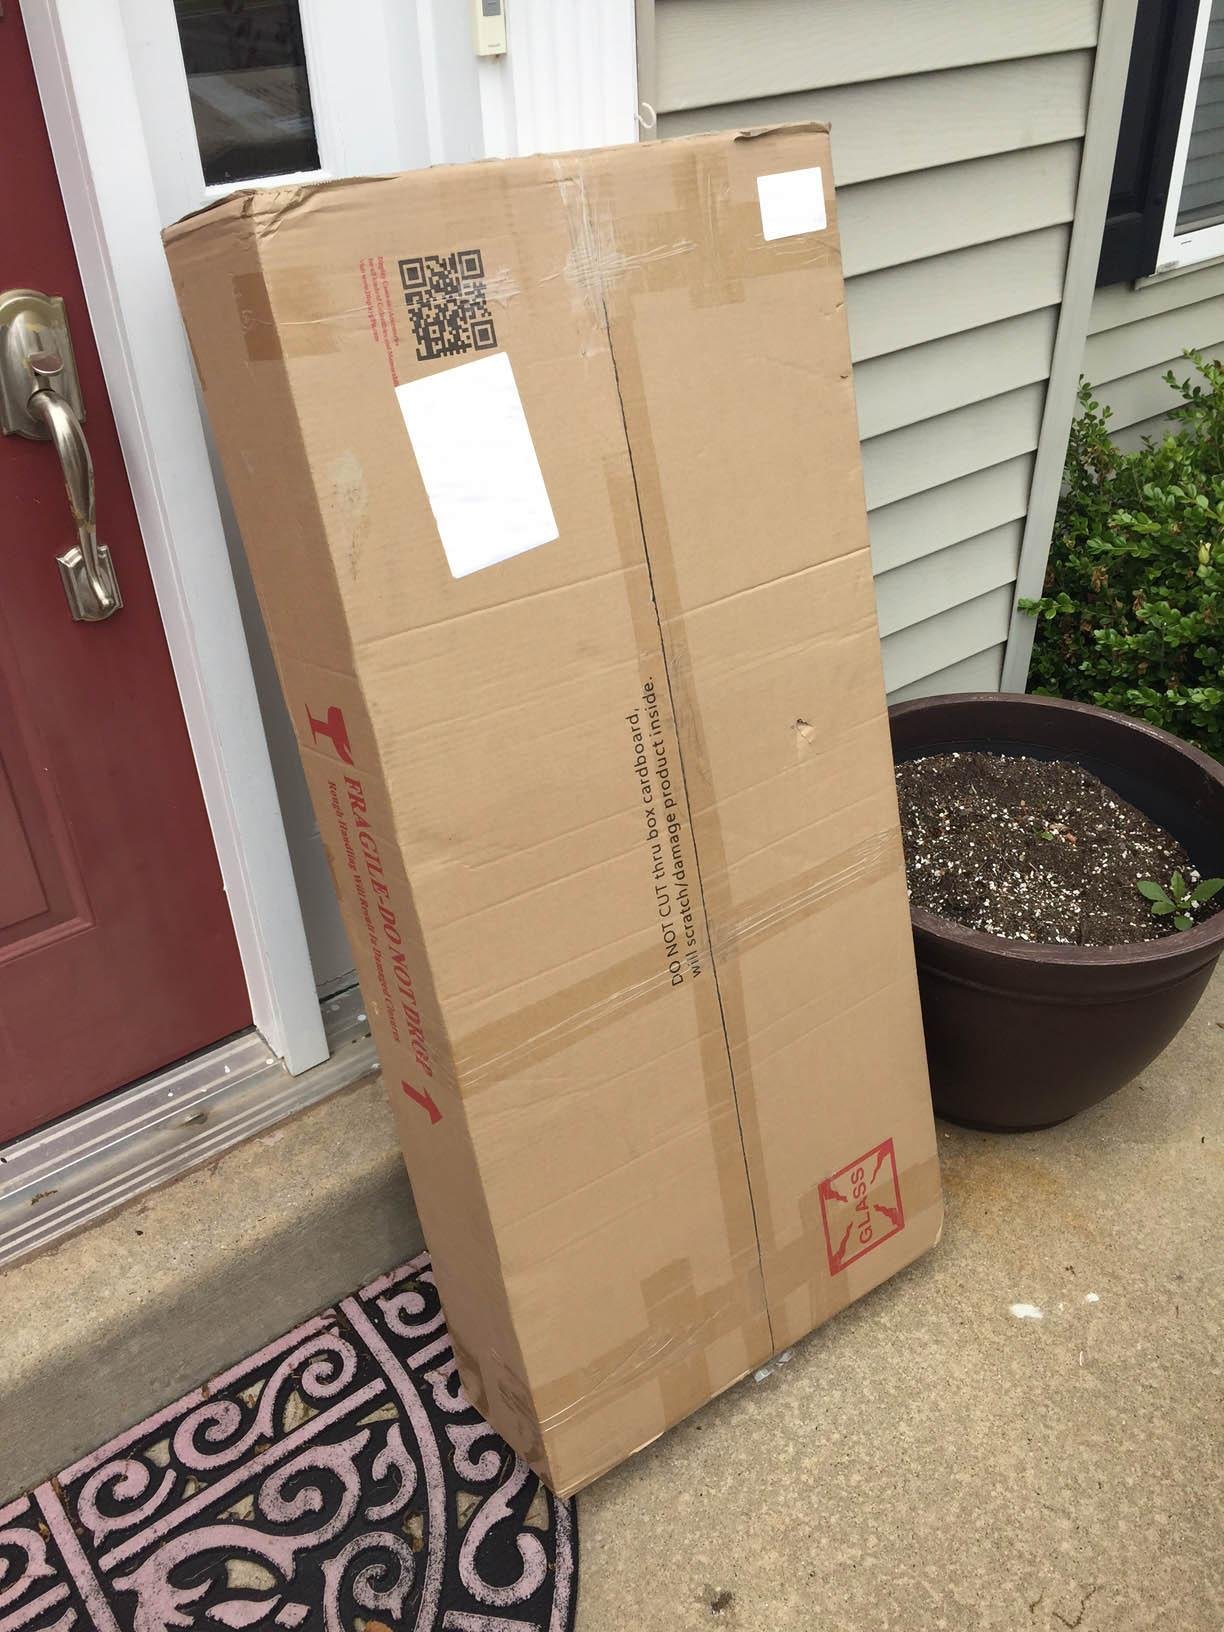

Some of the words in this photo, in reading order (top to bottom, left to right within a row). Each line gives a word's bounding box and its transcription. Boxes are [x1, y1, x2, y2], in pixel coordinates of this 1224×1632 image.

[641, 676, 662, 737] inside.
[625, 708, 653, 804] cardboard,
[652, 739, 678, 809] product
[645, 807, 659, 841] box
[327, 779, 344, 818] Rough
[338, 819, 357, 873] Handling
[353, 874, 367, 897] Will
[360, 897, 376, 934] Result
[372, 947, 391, 998] Damaged
[652, 844, 666, 880] thru
[666, 813, 697, 947] scratch/damage
[655, 885, 671, 917] CUT
[661, 922, 679, 957] NOT
[685, 950, 702, 978] will
[669, 960, 684, 986] DO
[388, 945, 416, 1006] NOT
[402, 1002, 433, 1077] DROP
[850, 1167, 873, 1244] GLASS
